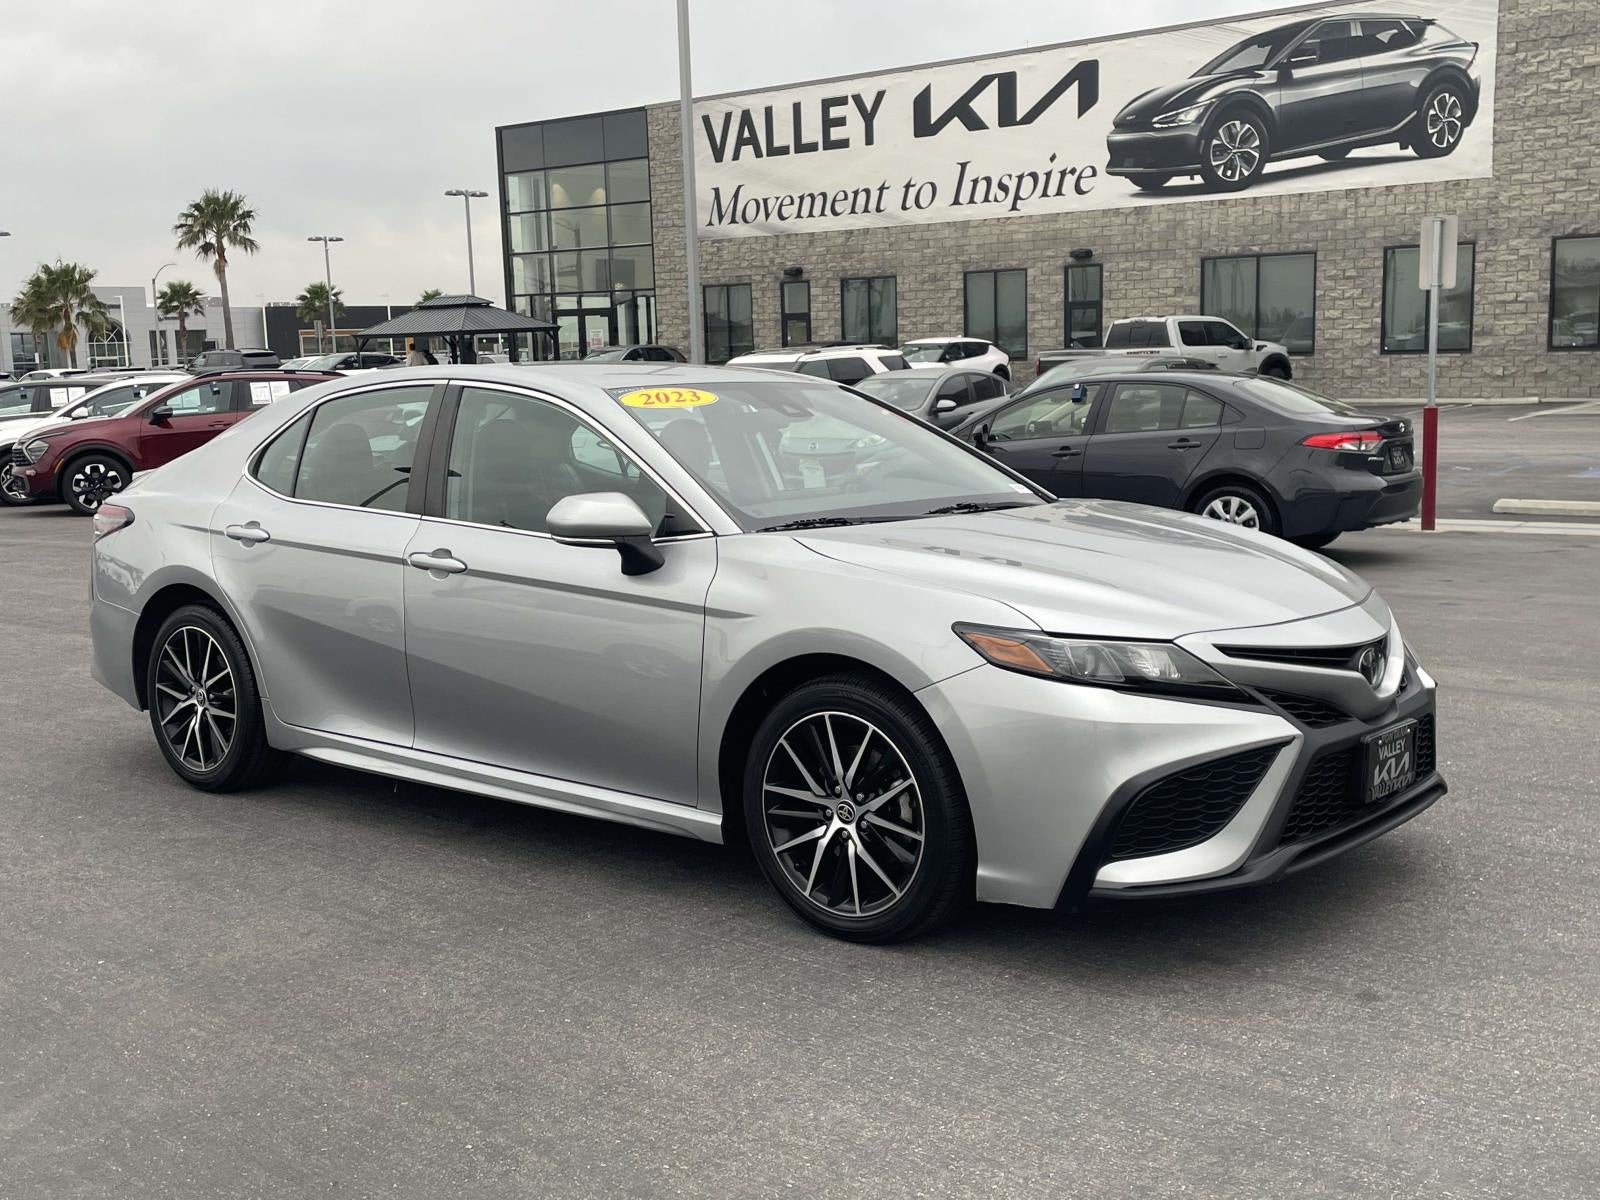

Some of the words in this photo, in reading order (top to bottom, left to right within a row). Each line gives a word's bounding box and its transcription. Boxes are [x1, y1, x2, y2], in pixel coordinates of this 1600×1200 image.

[701, 90, 886, 163] VALLEY
[913, 59, 1099, 138] KIA
[705, 180, 891, 227] Movement
[901, 177, 937, 211] to
[949, 152, 1098, 212] Inspire
[639, 390, 702, 406] 2023
[1378, 737, 1406, 760] VALLEY
[1373, 751, 1410, 786] KIA
